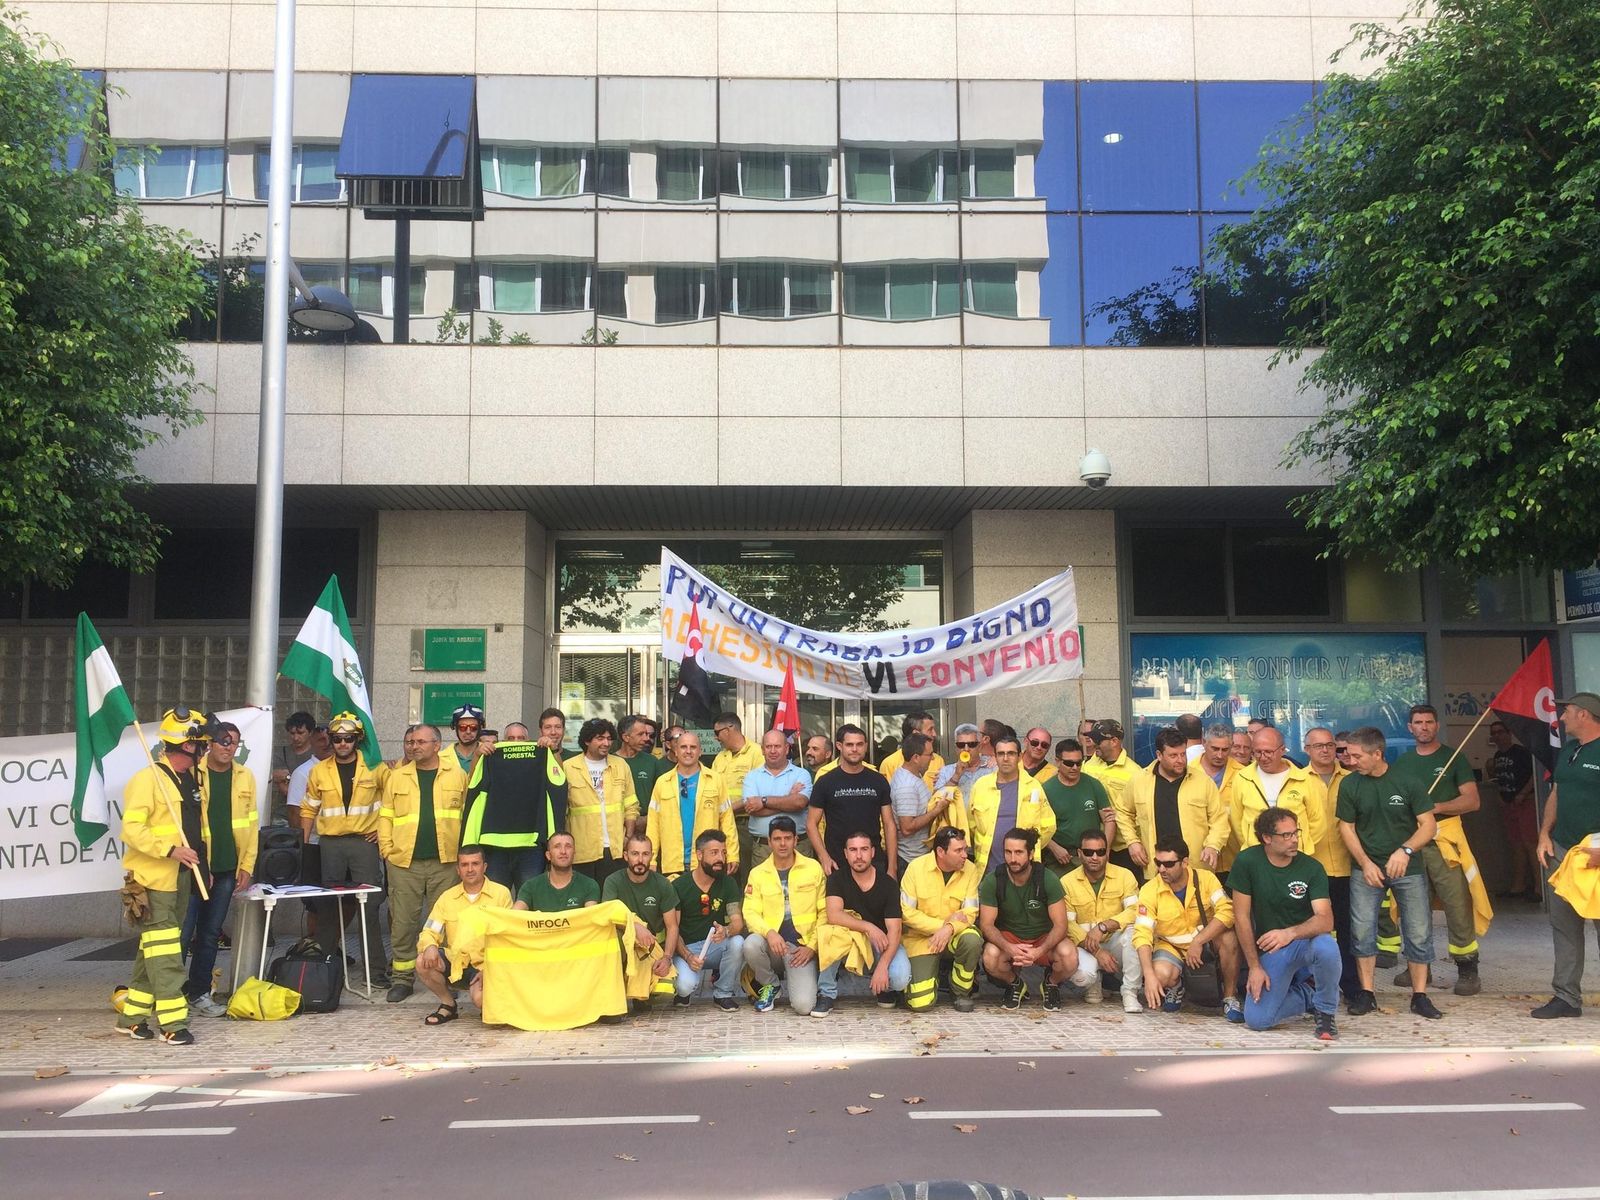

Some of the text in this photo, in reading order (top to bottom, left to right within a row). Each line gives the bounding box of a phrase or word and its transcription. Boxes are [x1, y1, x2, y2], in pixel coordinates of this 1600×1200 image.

[729, 602, 769, 635] UN
[862, 661, 898, 693] VI
[1141, 656, 1213, 680] PERMISO
[1219, 656, 1240, 680] DE
[1246, 656, 1332, 680] CONDUCIR
[1336, 656, 1350, 680] Y
[503, 752, 536, 760] FORESTAL
[7, 806, 38, 828] VI
[60, 841, 94, 865] DE
[527, 918, 571, 928] INFOCA
